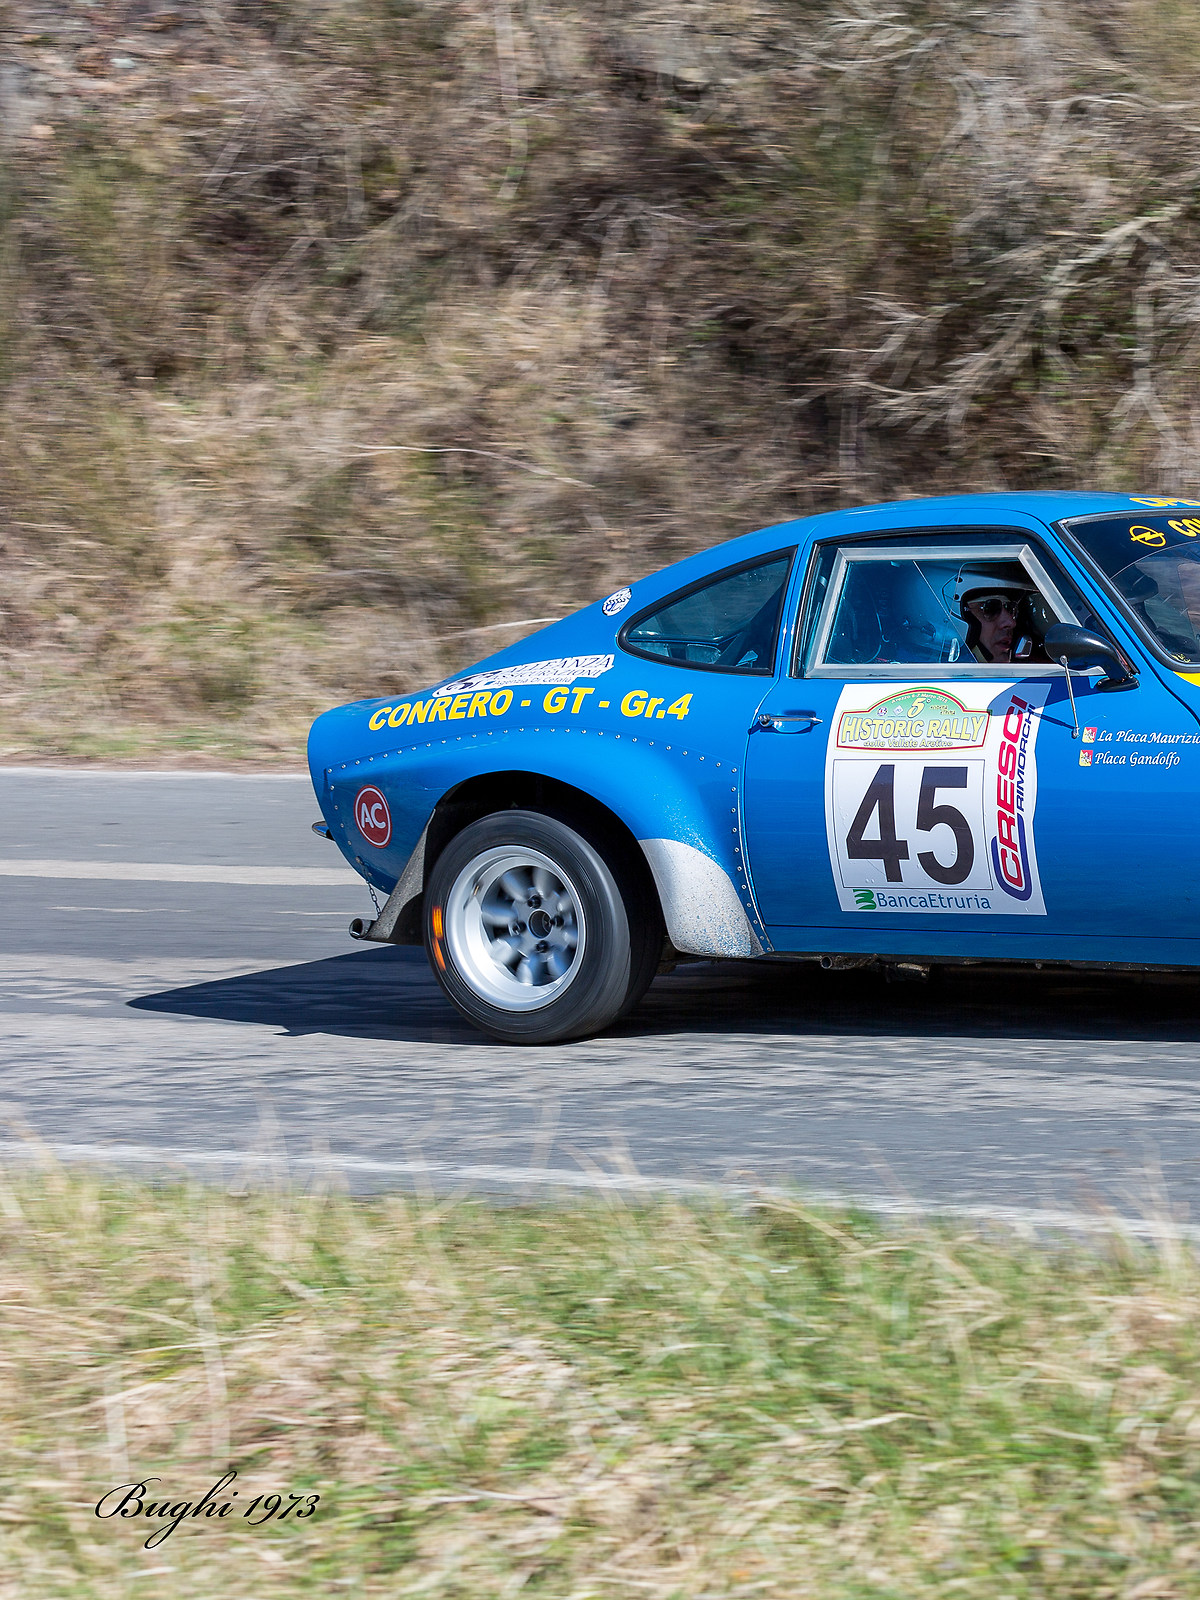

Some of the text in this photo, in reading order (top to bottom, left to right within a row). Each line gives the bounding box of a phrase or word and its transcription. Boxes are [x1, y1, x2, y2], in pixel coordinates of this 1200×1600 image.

[368, 689, 514, 731] CONRERO
[542, 687, 596, 714] GT
[620, 690, 694, 720] Gr.4
[841, 715, 986, 743] HISTORIC RALLY
[887, 738, 919, 748] Vallate
[1097, 730, 1112, 742] La
[1115, 729, 1147, 742] Placa
[1016, 704, 1036, 813] RIMORCHI
[1094, 751, 1181, 770] Placa Gandolfo
[997, 694, 1028, 888] CRESCI
[361, 801, 387, 829] AC
[845, 764, 975, 885] 45
[876, 892, 992, 910] BancaEtruria
